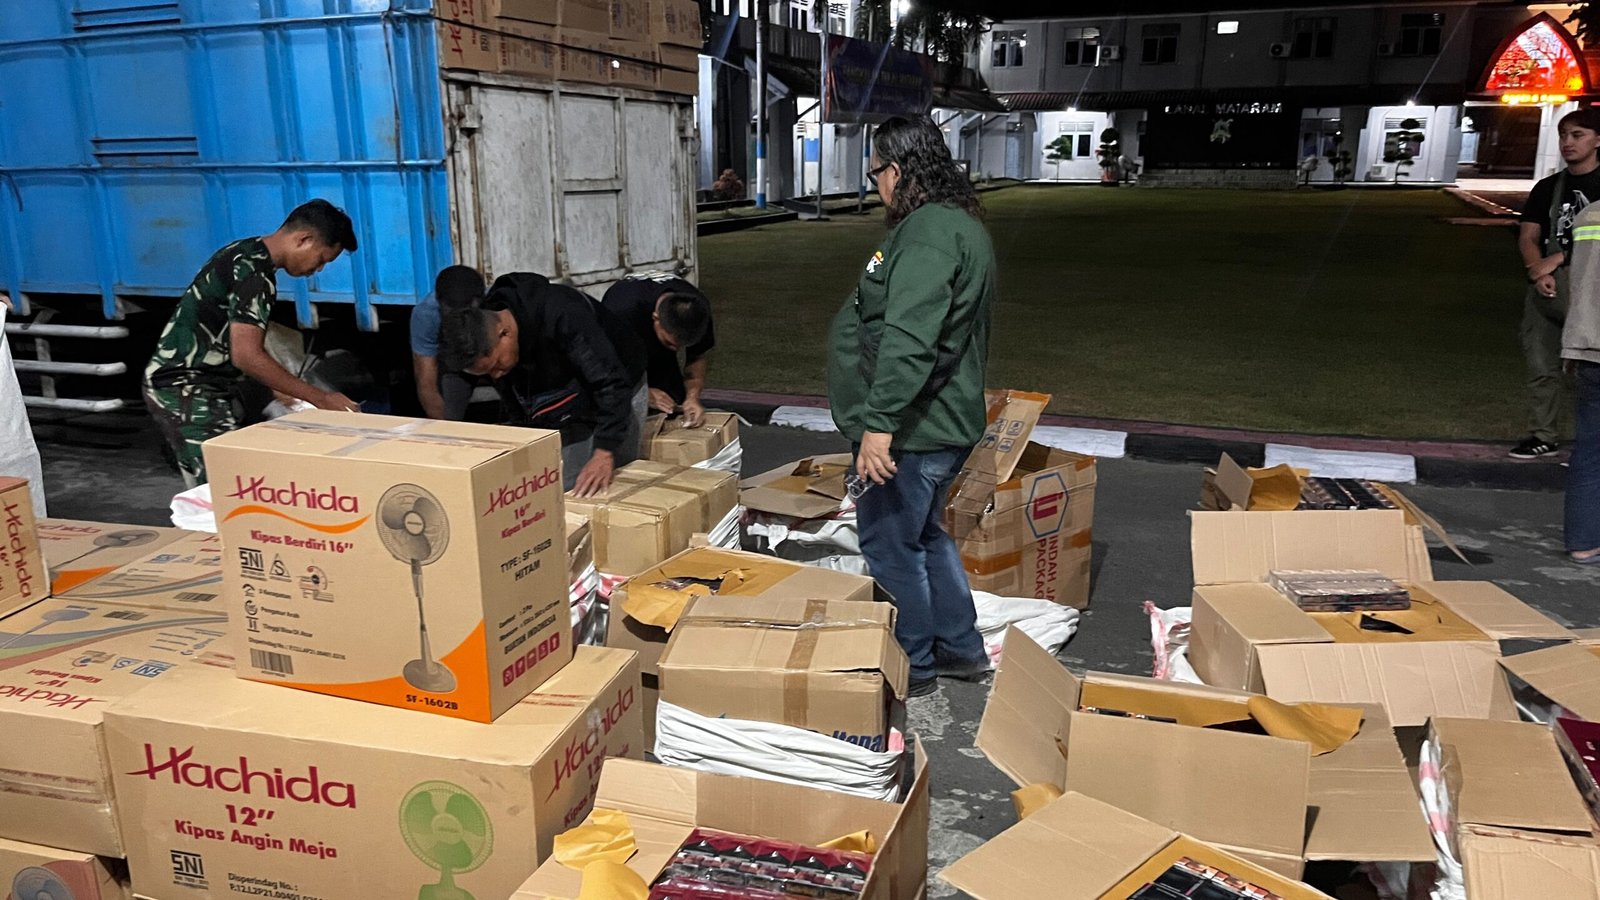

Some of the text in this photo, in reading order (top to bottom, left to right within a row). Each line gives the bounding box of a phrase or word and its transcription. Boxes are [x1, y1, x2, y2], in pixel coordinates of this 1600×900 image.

[225, 474, 359, 513] Hachida
[482, 467, 560, 517] Hachida
[3, 500, 32, 598] Hachida
[239, 549, 264, 569] SNI
[251, 530, 283, 544] Kipas
[284, 535, 327, 551] Berdiri
[1048, 535, 1060, 583] INDAH
[514, 560, 541, 582] HITAM
[125, 742, 356, 809] Hachida
[174, 819, 338, 860] Kipas Angin Meja
[171, 853, 204, 875] SNI
